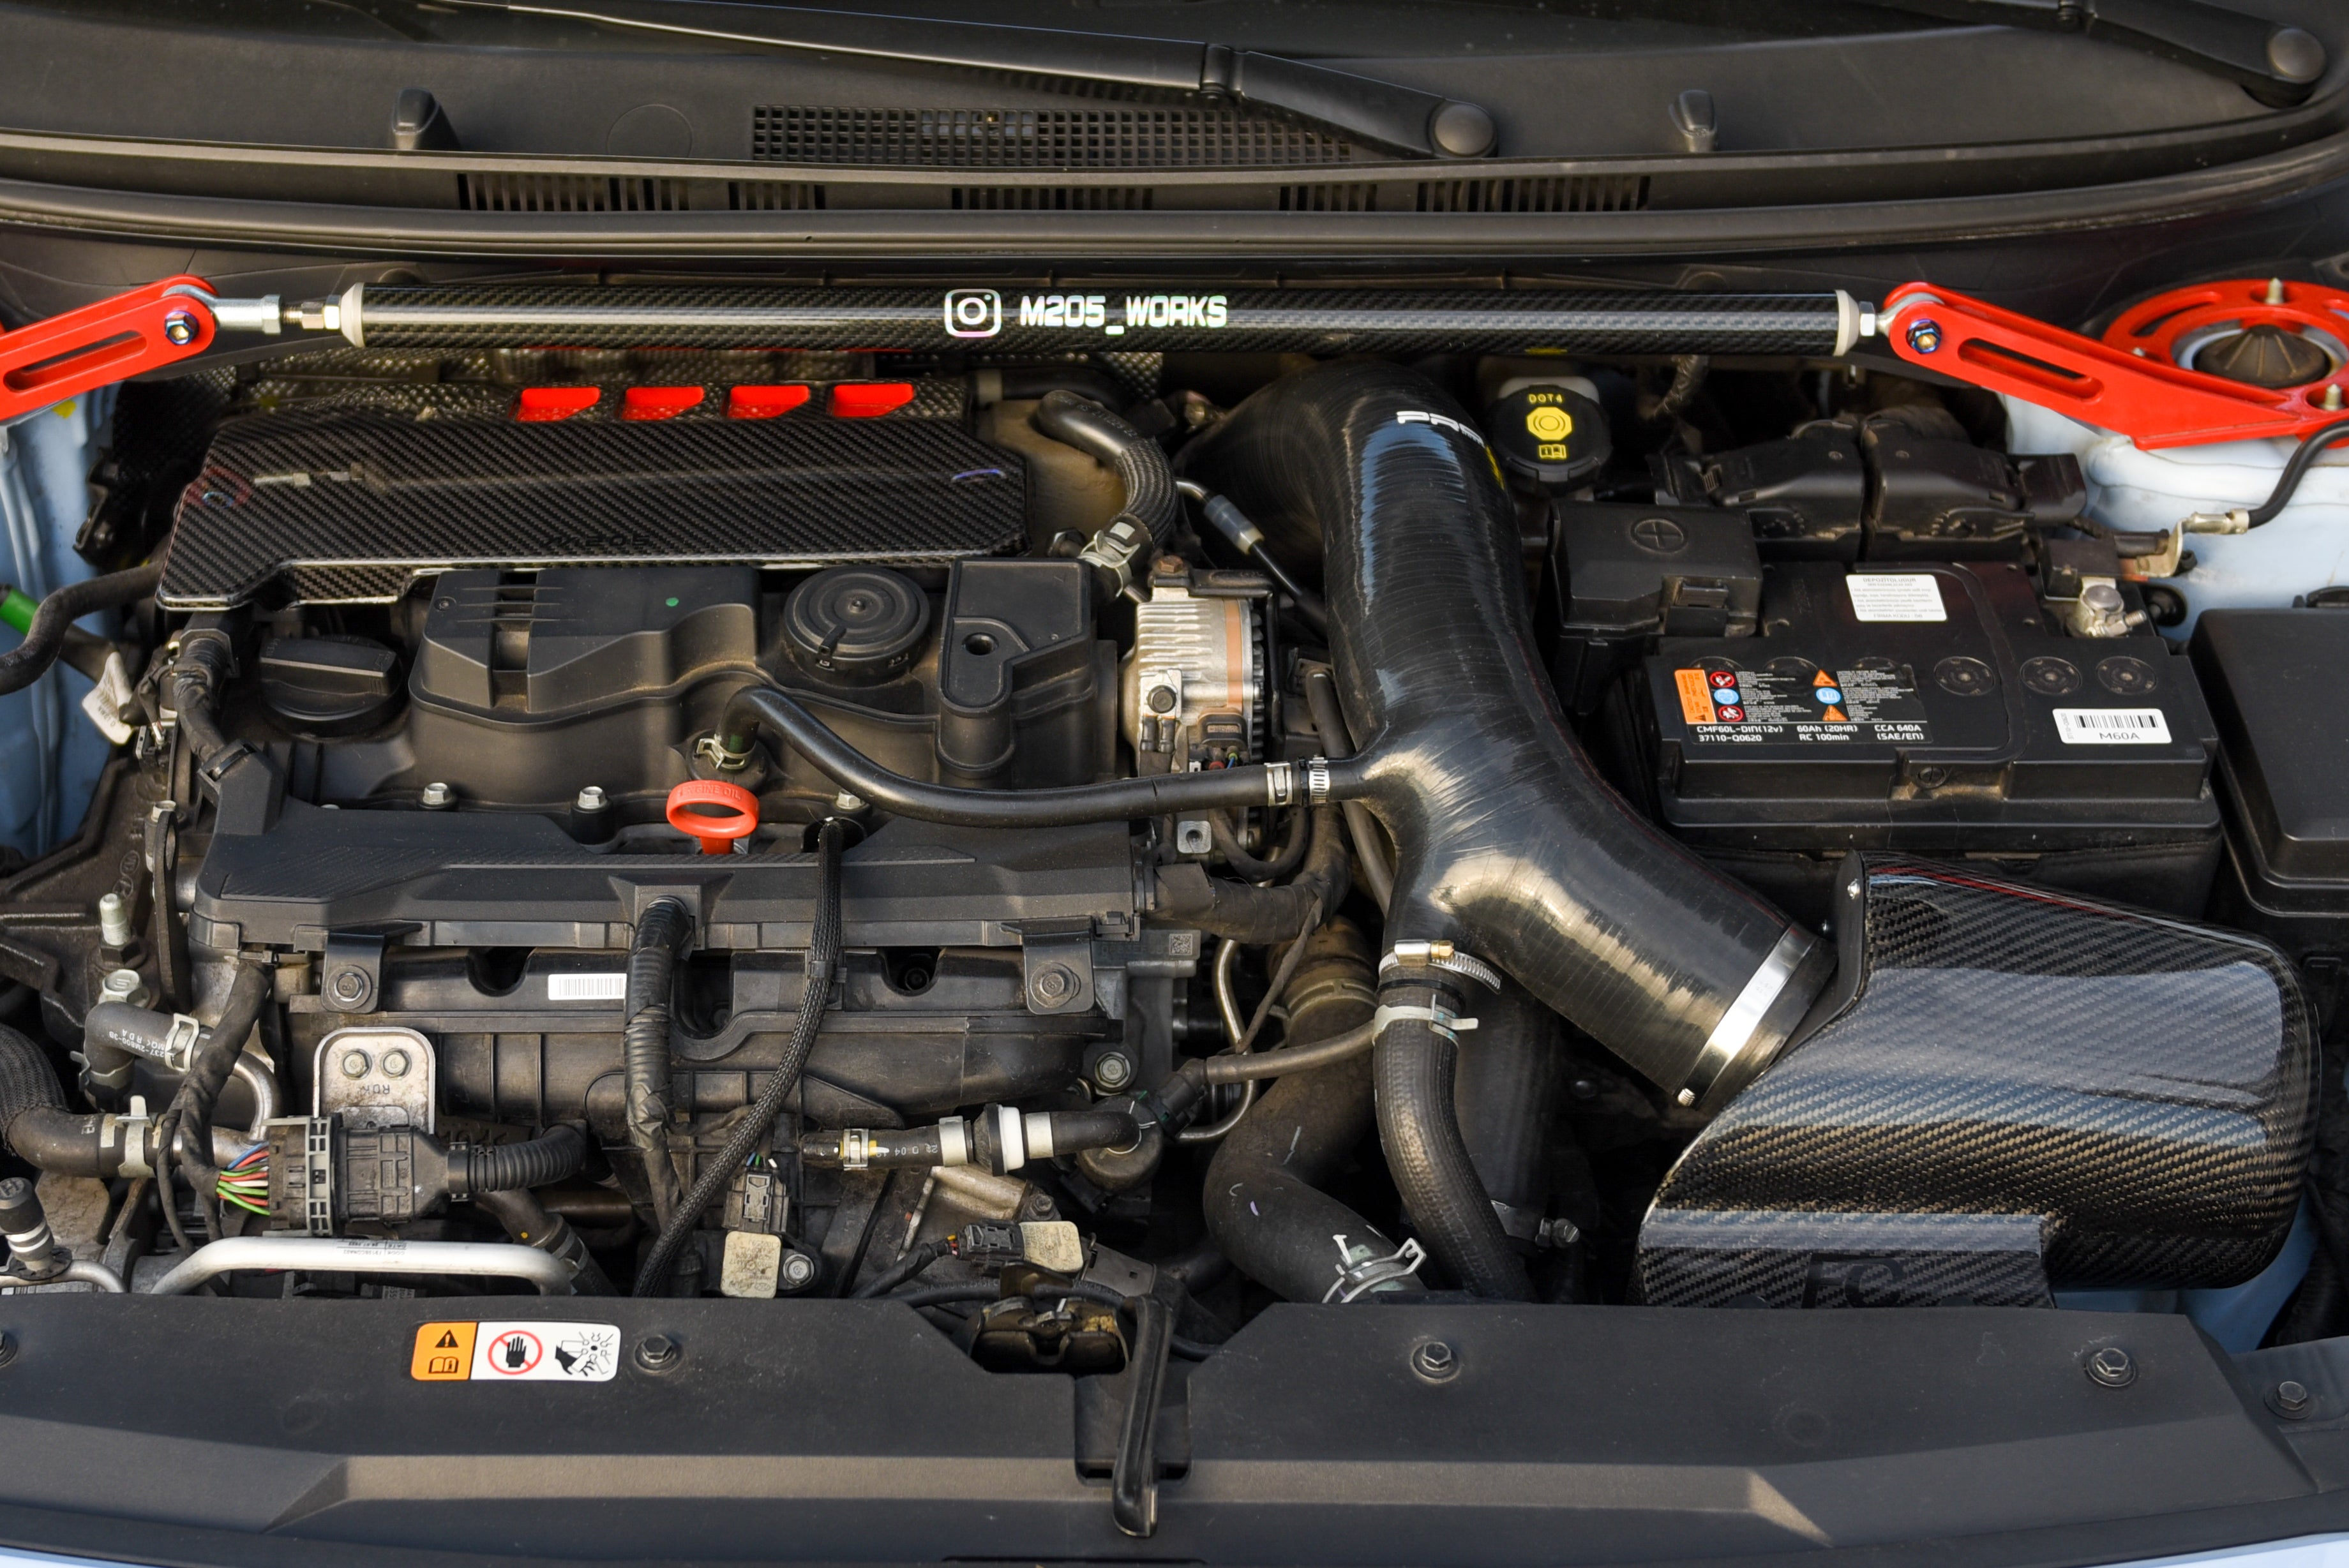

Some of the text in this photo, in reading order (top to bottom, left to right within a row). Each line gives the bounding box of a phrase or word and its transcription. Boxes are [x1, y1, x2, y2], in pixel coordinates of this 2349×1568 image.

[1020, 295, 1227, 336] M205_WORKS
[1824, 724, 1858, 733] (20HR)
[1699, 734, 1762, 742] 37110-Q0620
[2099, 732, 2140, 740] M60A
[682, 784, 721, 795] ENGINE
